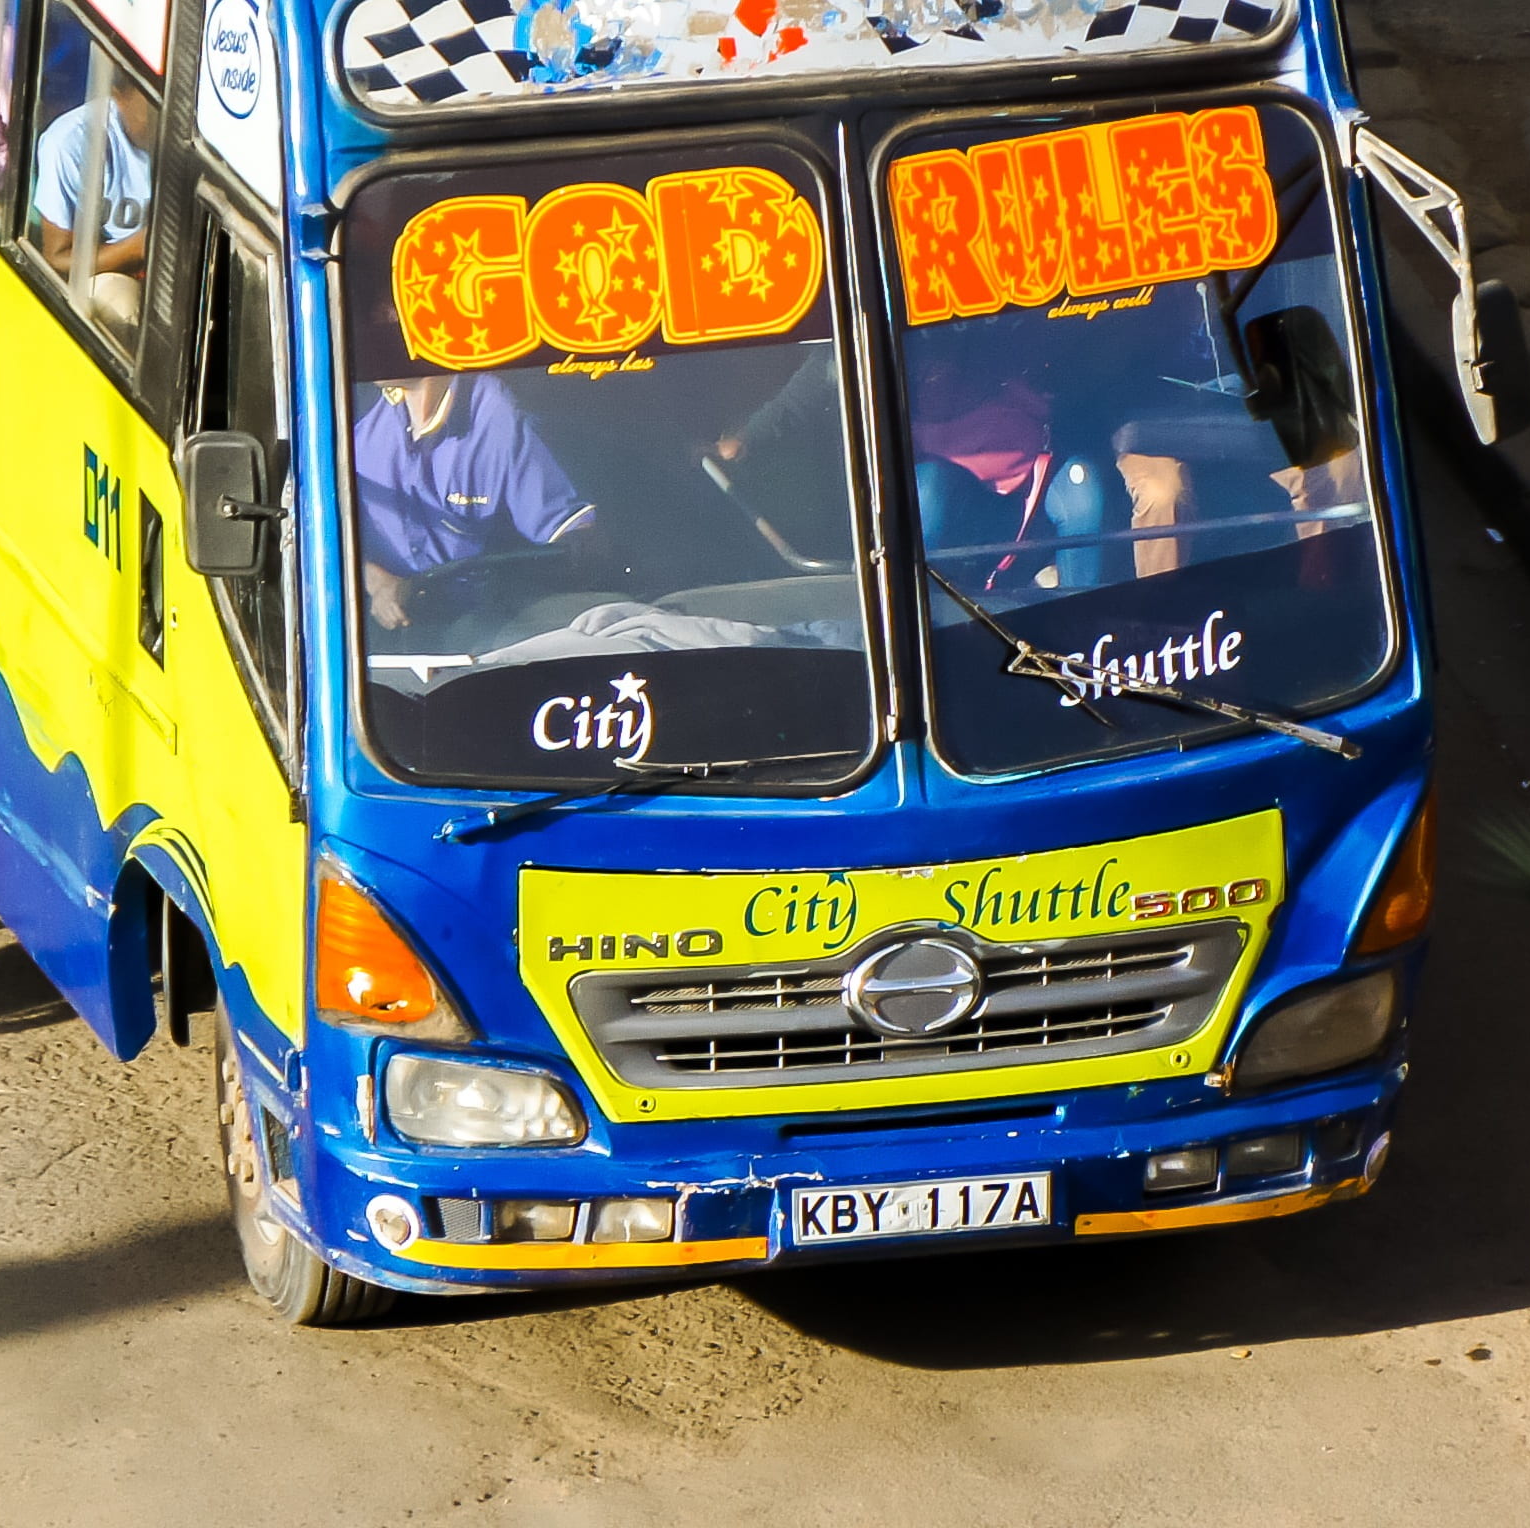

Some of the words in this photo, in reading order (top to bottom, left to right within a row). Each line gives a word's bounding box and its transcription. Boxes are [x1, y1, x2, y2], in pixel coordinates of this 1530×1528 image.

[211, 16, 248, 54] Jesus
[220, 58, 257, 94] inside
[889, 104, 1279, 327] RULES
[391, 164, 824, 372] GOD
[1047, 296, 1110, 320] always
[1112, 284, 1154, 311] will
[547, 353, 618, 380] always
[619, 350, 654, 372] has
[1059, 610, 1243, 707] Shuttle
[532, 684, 660, 772] City
[743, 877, 858, 950] City
[937, 858, 1131, 932] Shuttle
[1130, 877, 1267, 923] 500
[547, 928, 725, 963] HINO
[800, 1191, 889, 1237] KBY
[928, 1181, 1040, 1229] 117A
